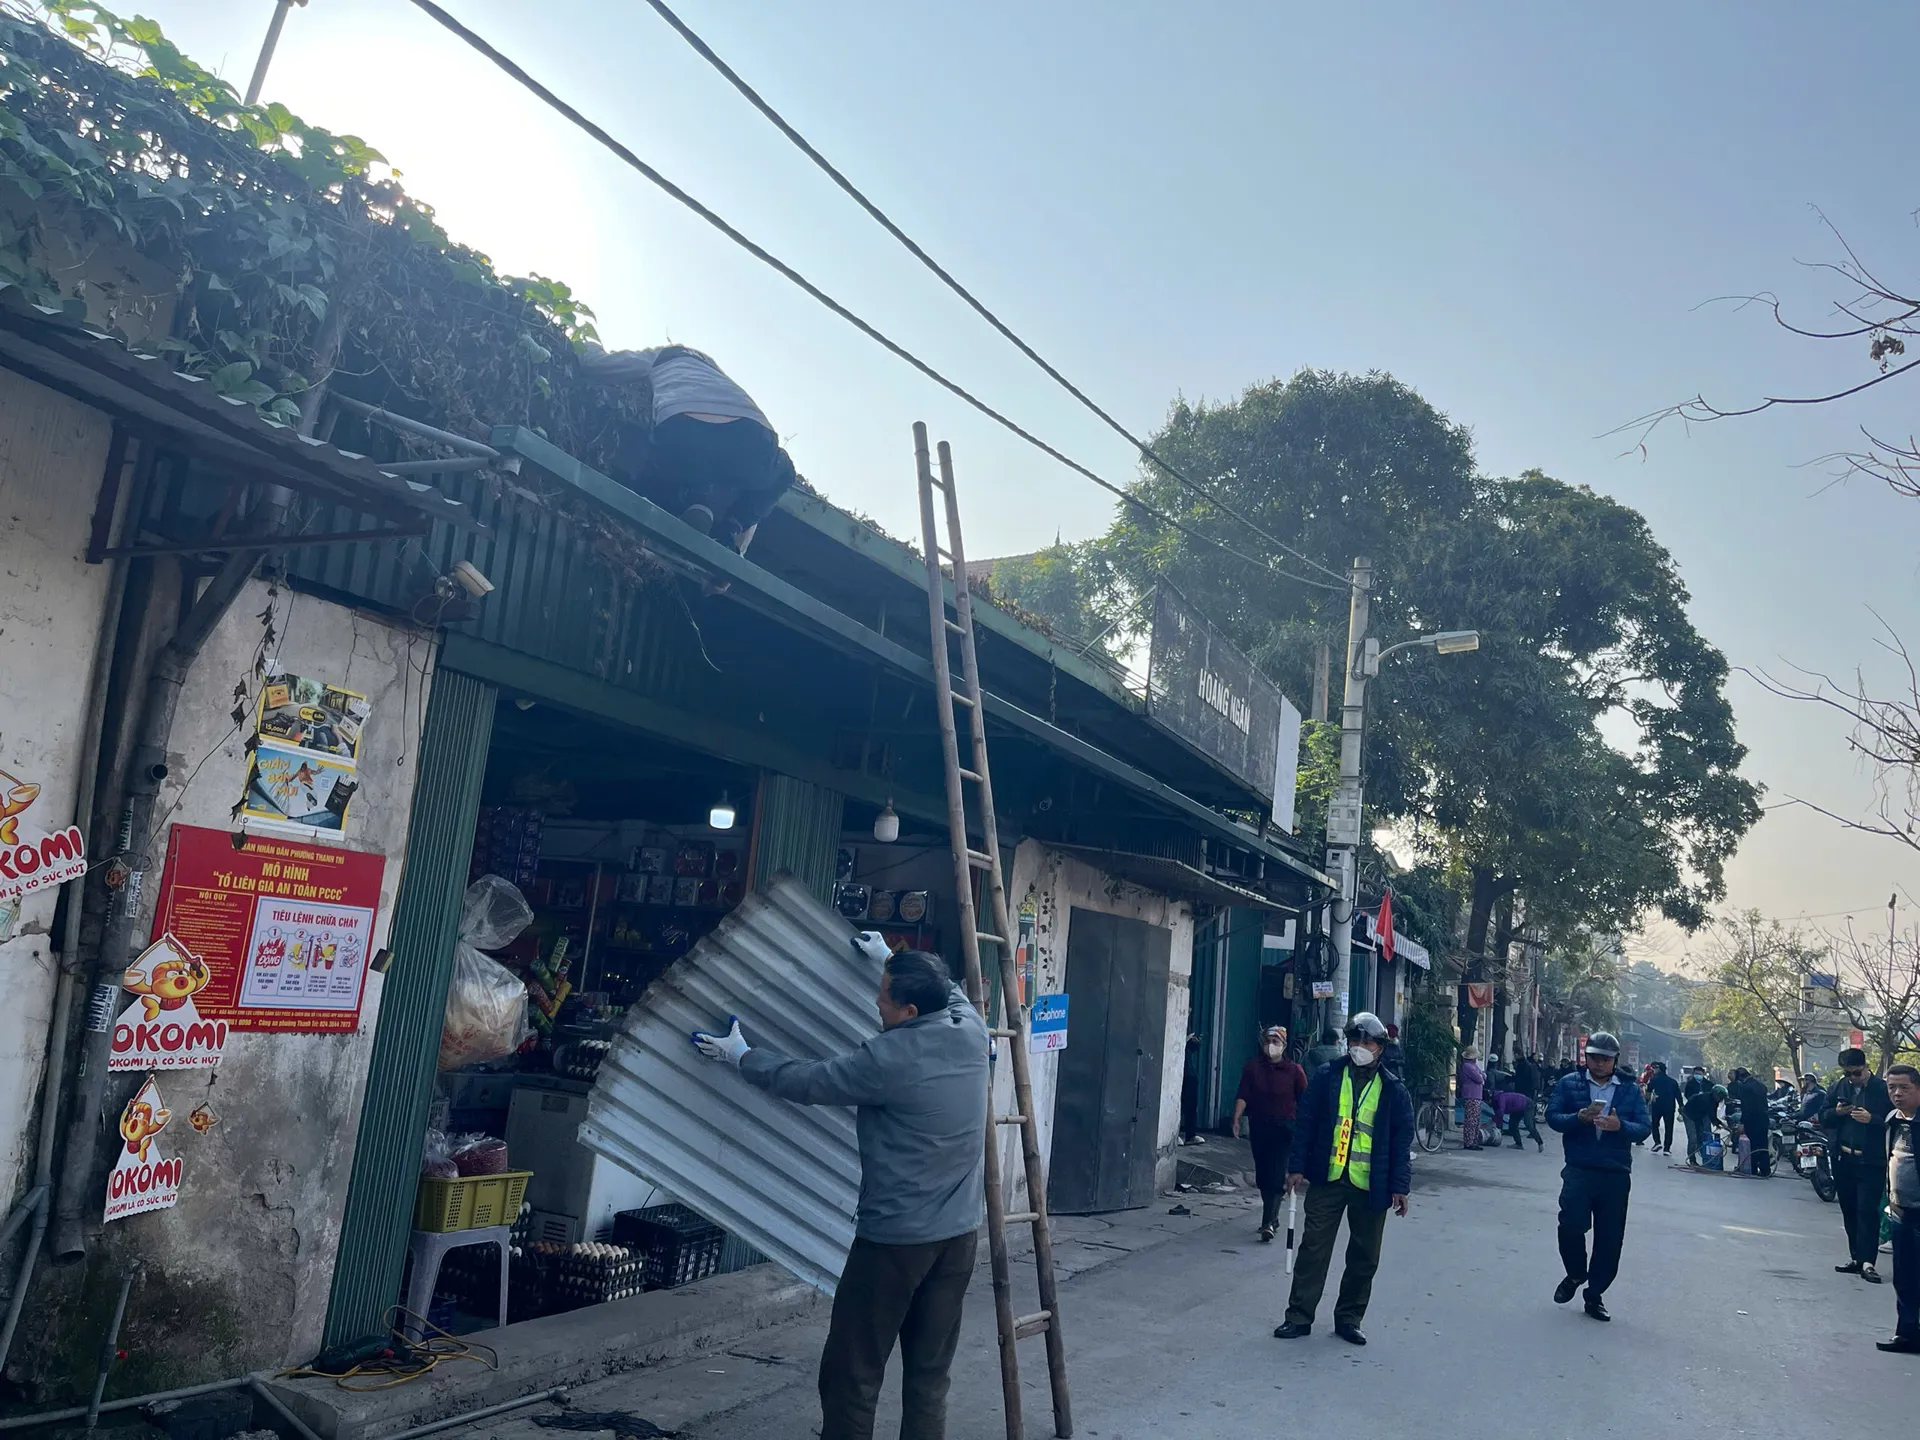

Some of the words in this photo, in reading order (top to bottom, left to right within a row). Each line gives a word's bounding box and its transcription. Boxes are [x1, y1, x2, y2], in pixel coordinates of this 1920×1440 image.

[1198, 668, 1230, 717] HOÀNG
[257, 844, 275, 854] NHÂN
[276, 846, 289, 856] DÂN
[290, 848, 314, 860] PHƯỜNG
[316, 853, 334, 863] THANH
[336, 855, 345, 864] TRÌ
[26, 878, 39, 889] CÓ
[42, 871, 63, 884] SỨC
[262, 861, 280, 877] MÔ
[282, 865, 310, 881] HÌNH
[232, 875, 257, 890] LIÊN
[257, 880, 274, 893] GIA
[276, 882, 291, 895] AN
[293, 883, 317, 898] TOÀN
[272, 909, 291, 922] TIÊU
[292, 912, 314, 925] LỆNH
[316, 913, 337, 926] CHỮA
[338, 917, 359, 928] CHÁY
[272, 928, 277, 936] 1
[145, 1056, 158, 1066] LÀ
[162, 1056, 175, 1065] CÓ
[178, 1055, 198, 1065] SỨC
[202, 1054, 221, 1065] HÚT
[1337, 1118, 1351, 1163] ANTT
